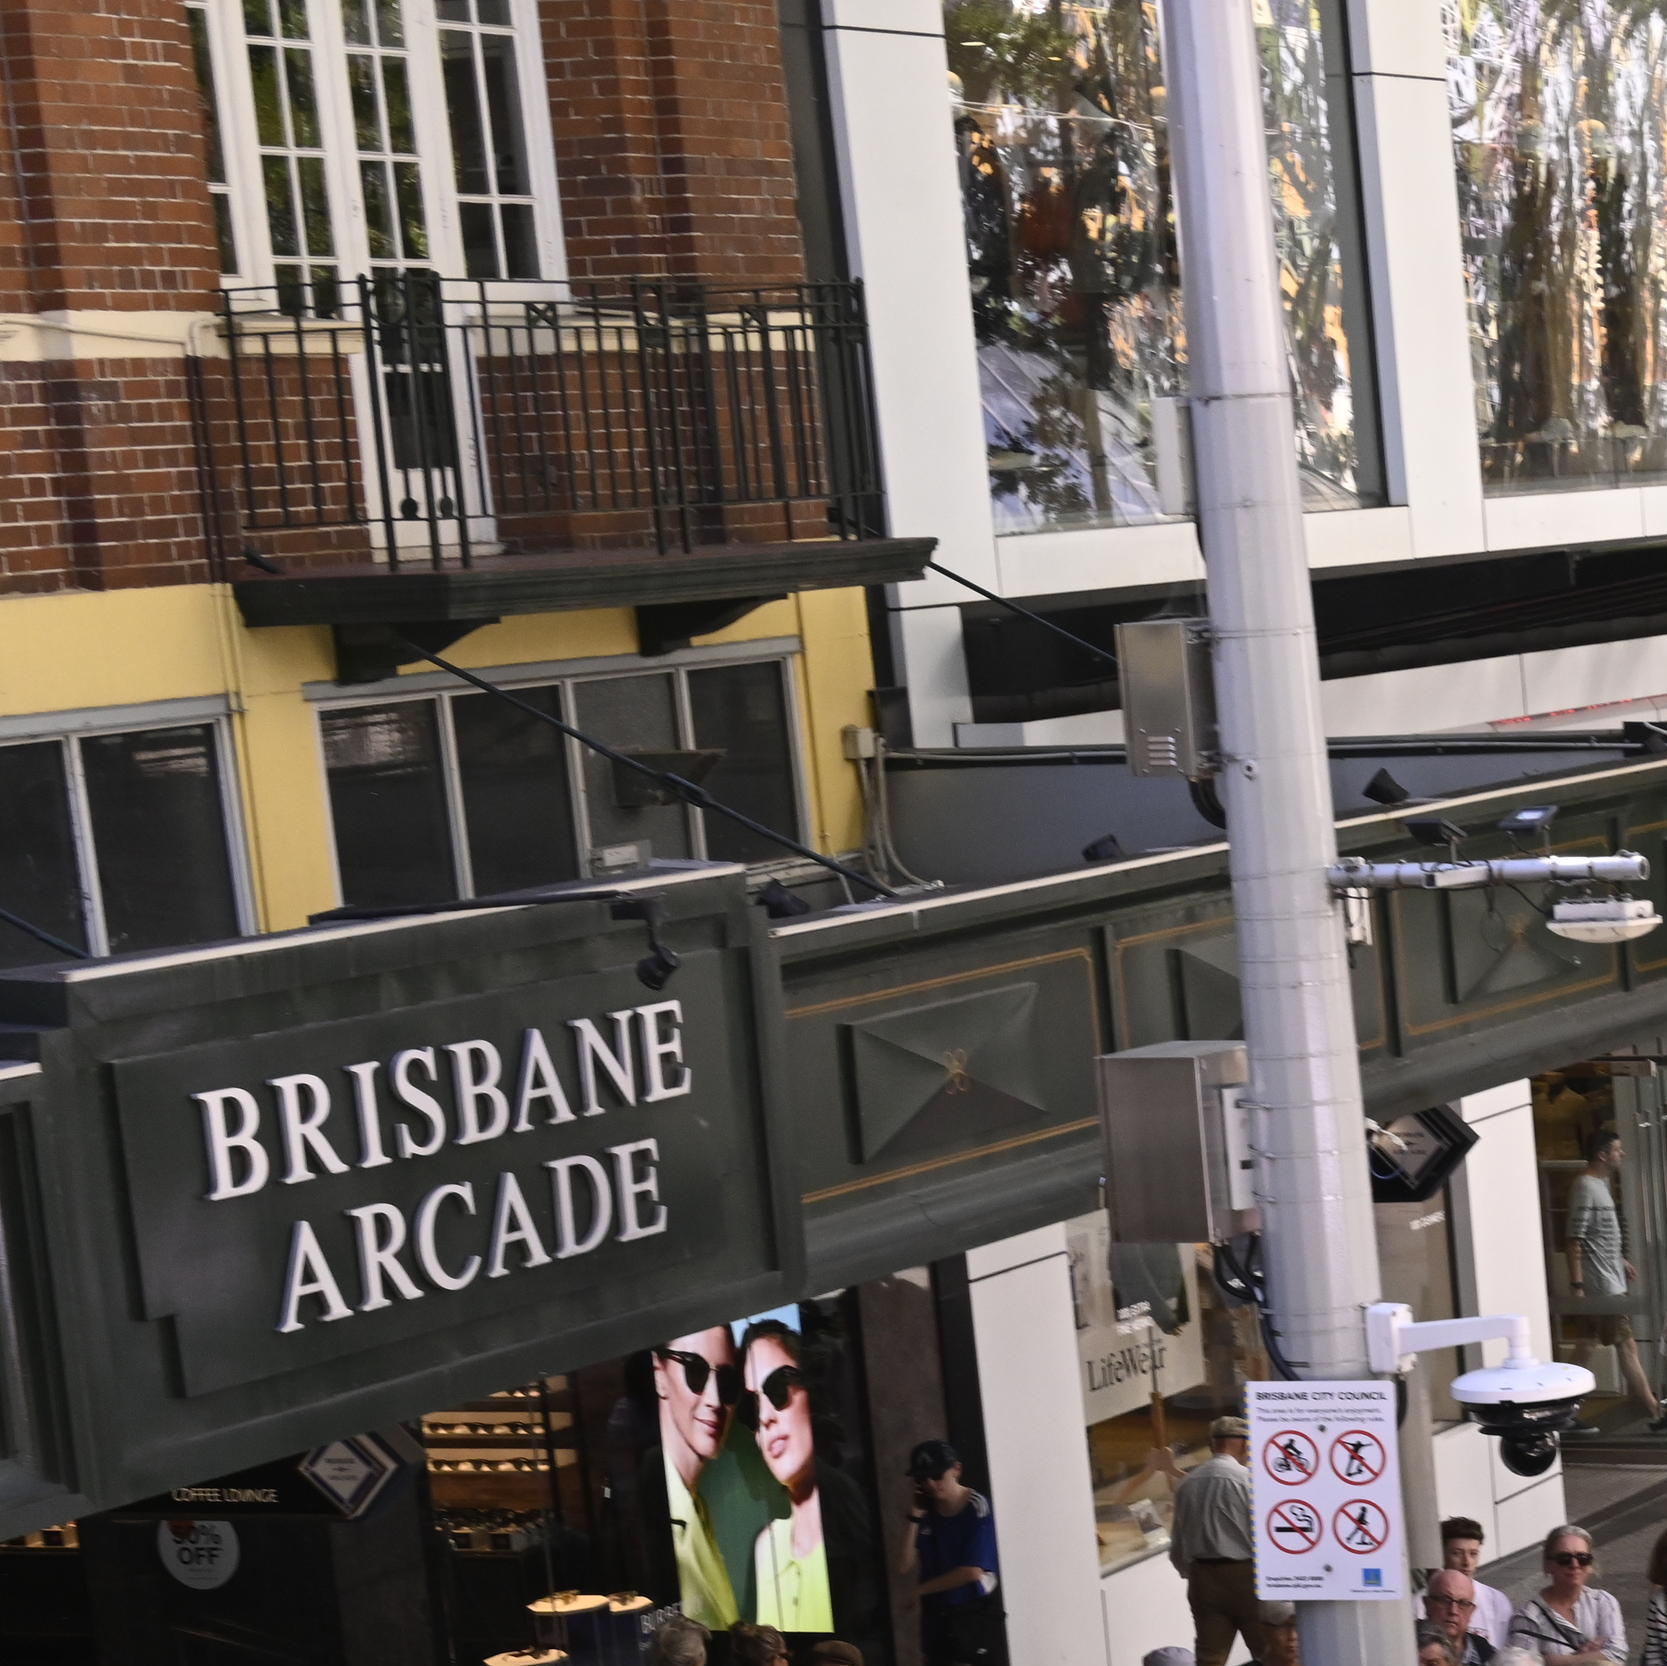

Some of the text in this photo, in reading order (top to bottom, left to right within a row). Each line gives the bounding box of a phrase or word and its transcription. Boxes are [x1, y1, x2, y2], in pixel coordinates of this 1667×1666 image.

[191, 1000, 693, 1202] BRISBANE
[276, 1137, 670, 1333] ARCADE
[1256, 1391, 1388, 1401] BRISBANE CITY COUNCIL
[172, 1488, 280, 1503] COFFEE LOUNGE
[177, 1546, 222, 1565] OFF
